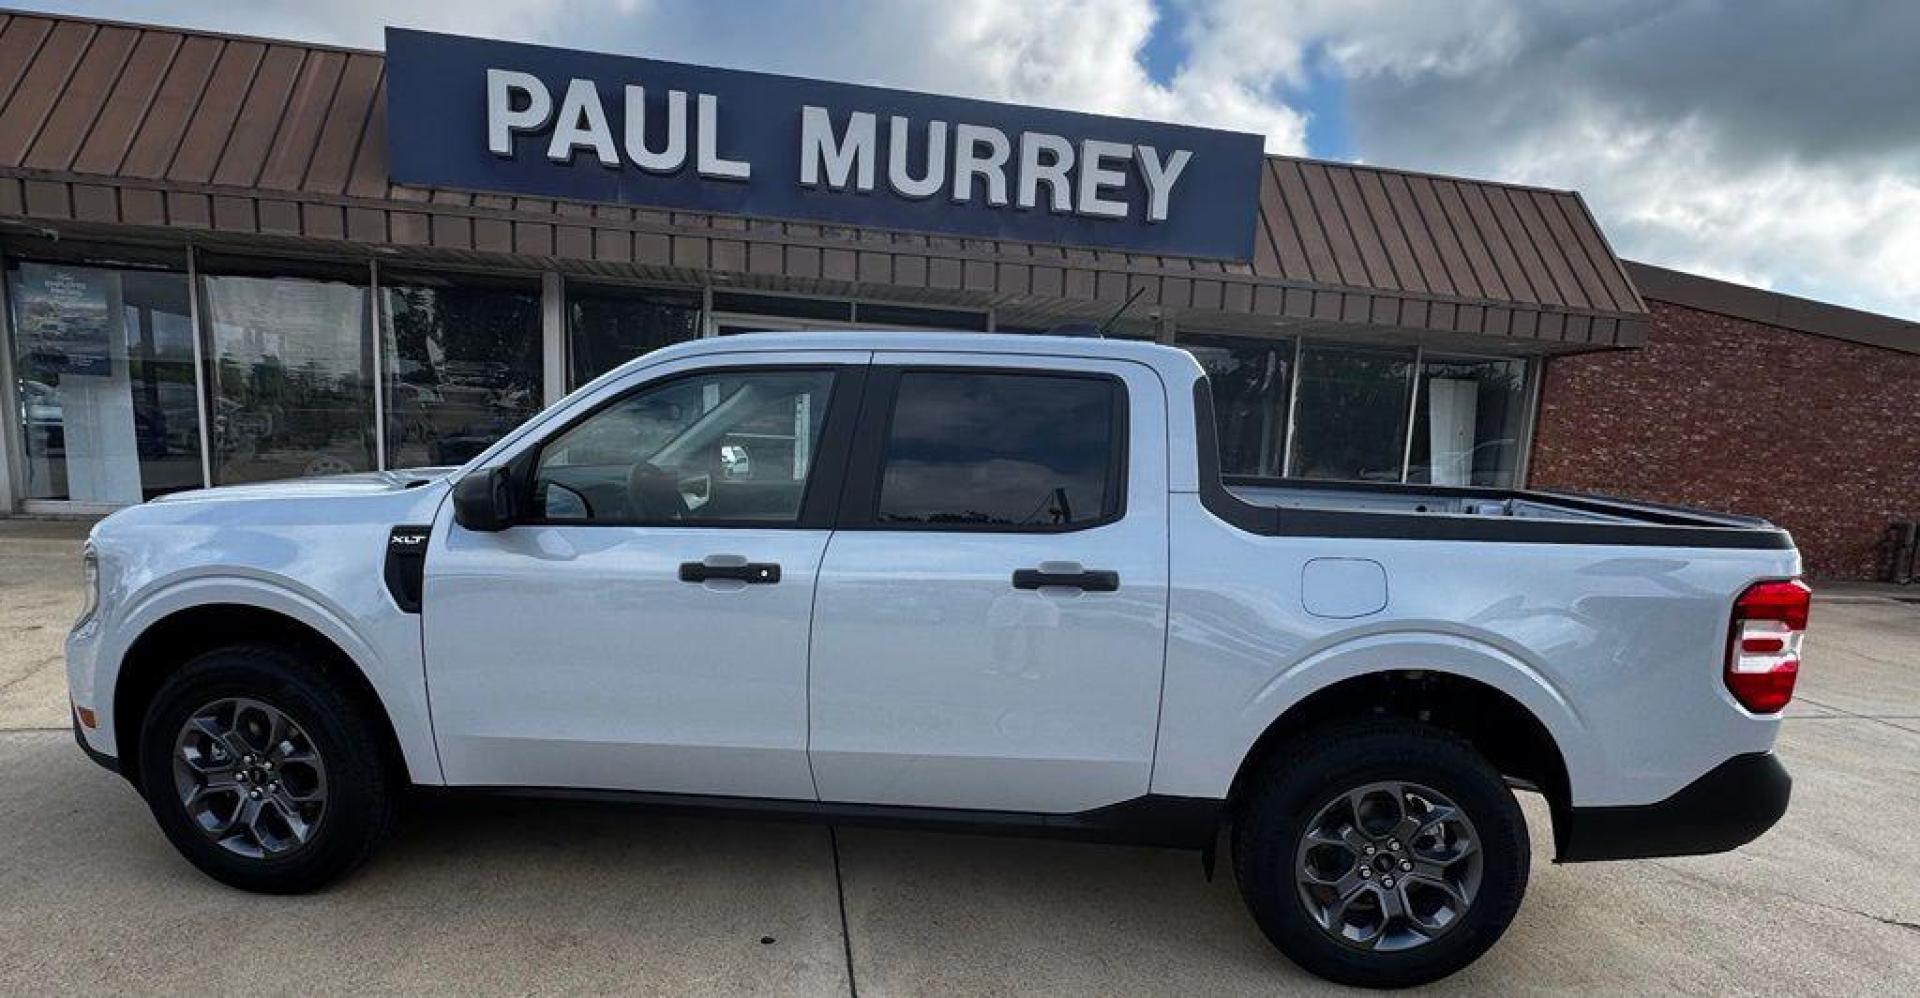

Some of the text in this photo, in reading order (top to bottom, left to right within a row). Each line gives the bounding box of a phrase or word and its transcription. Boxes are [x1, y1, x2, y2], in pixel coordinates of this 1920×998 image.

[486, 68, 1193, 222] PAUL MURREY
[391, 535, 426, 545] XLT
